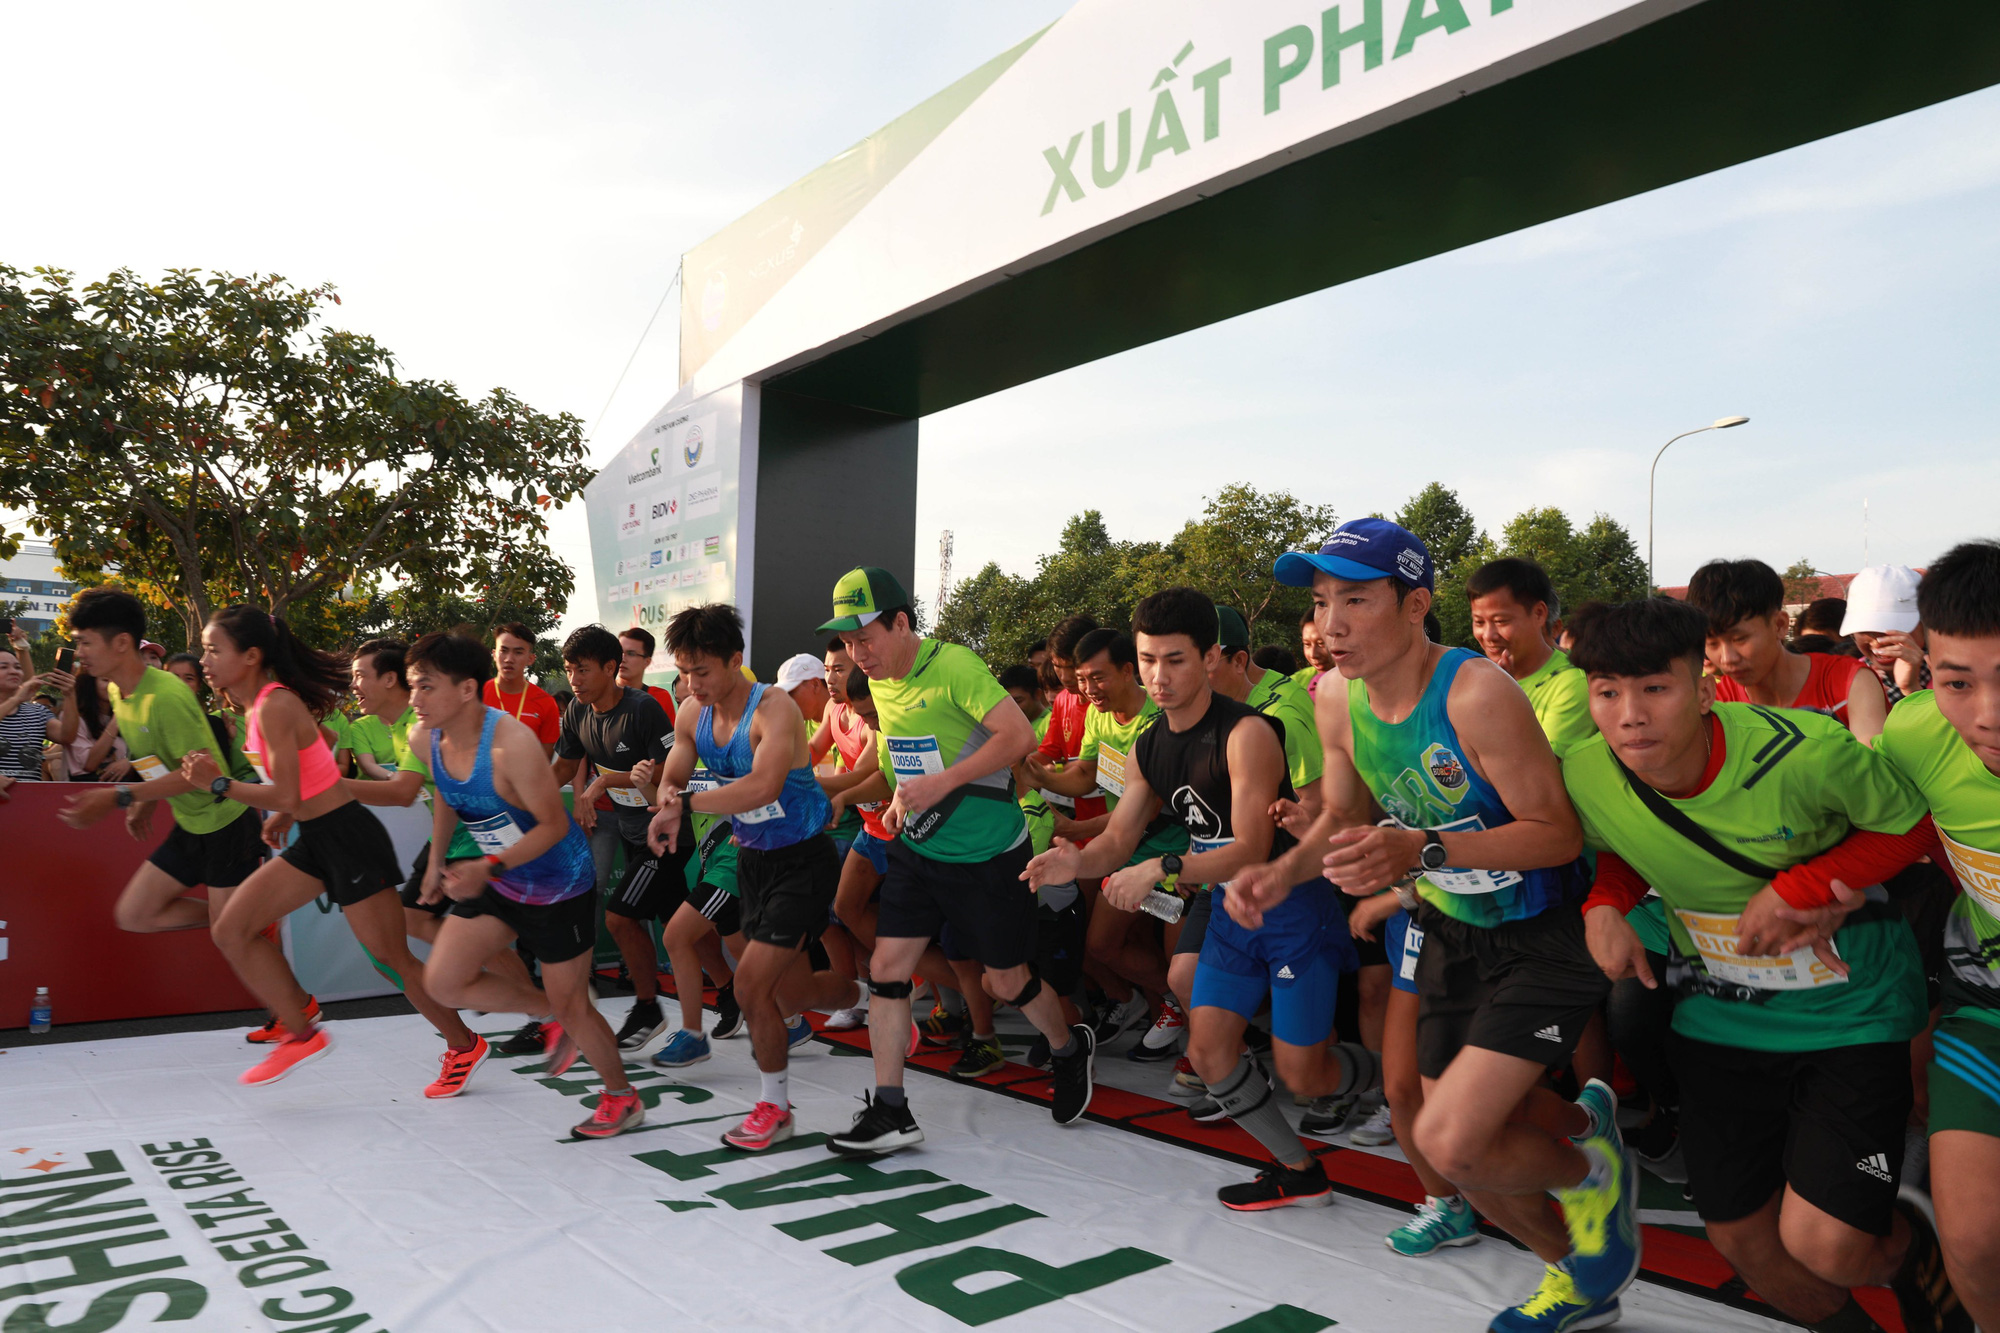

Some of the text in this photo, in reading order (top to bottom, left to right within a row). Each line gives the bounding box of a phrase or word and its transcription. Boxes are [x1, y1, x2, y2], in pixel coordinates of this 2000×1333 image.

[1039, 39, 1232, 217] XUẤT
[652, 500, 671, 519] BIDV
[891, 754, 923, 768] 100505
[140, 1137, 246, 1190] RISE
[1856, 1162, 1893, 1183] adidas
[184, 1187, 332, 1289] DELTA
